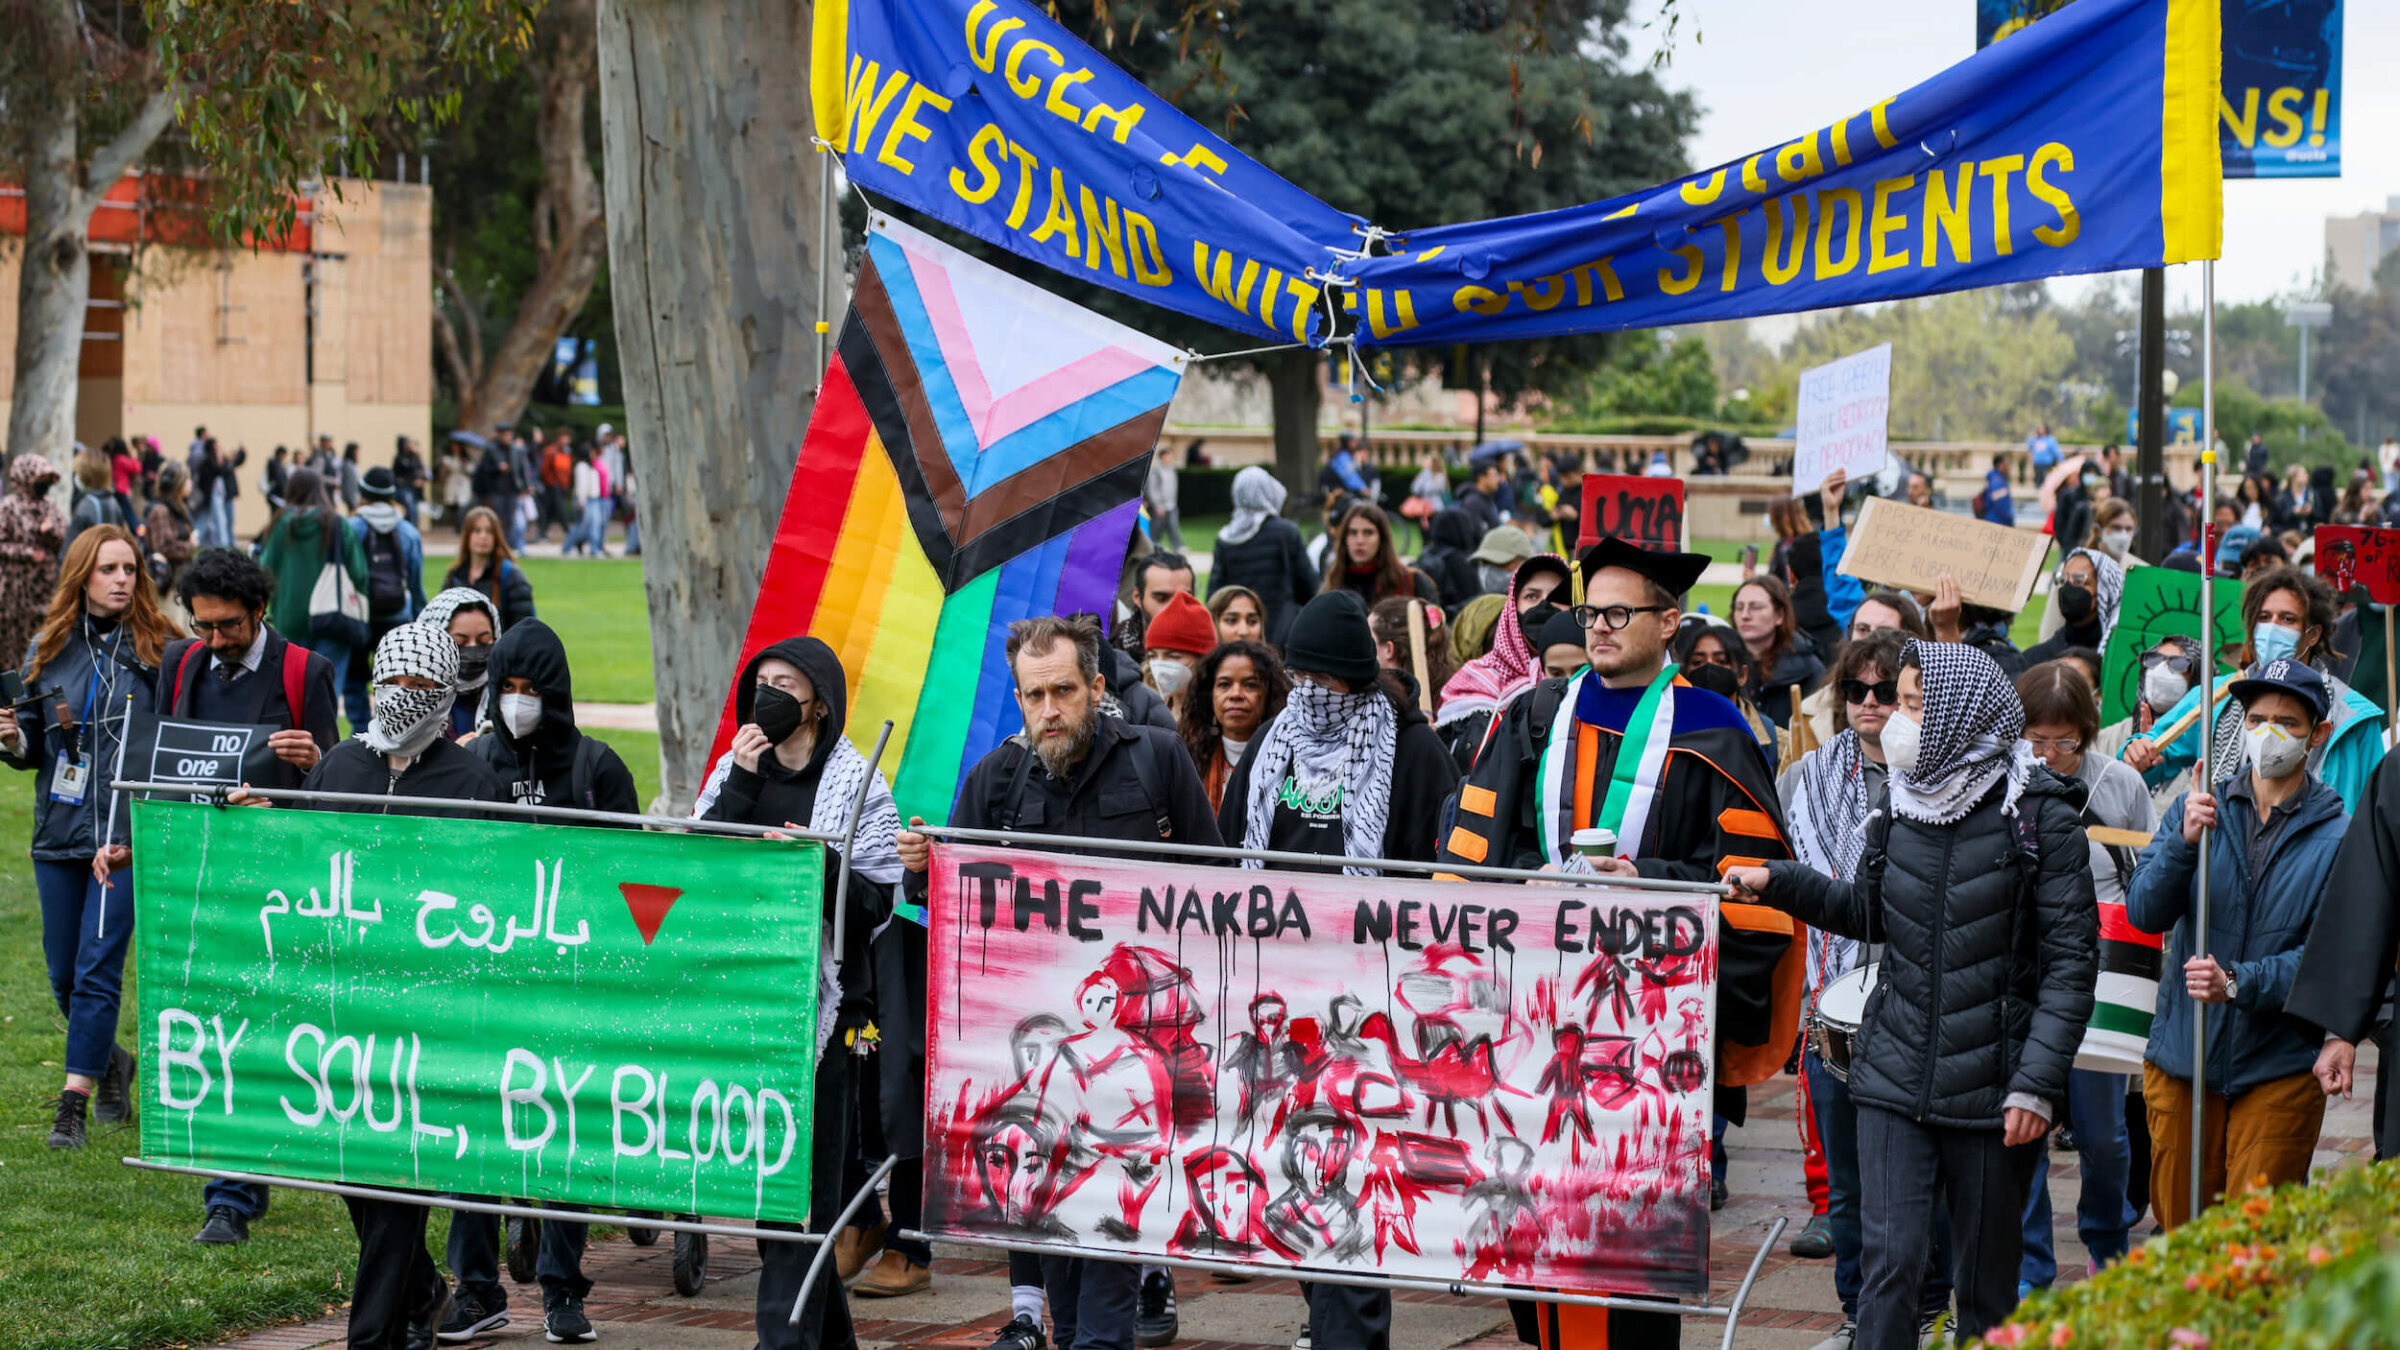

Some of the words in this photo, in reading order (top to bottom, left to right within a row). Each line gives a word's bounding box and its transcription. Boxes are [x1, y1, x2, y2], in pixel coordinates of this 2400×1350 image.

[846, 52, 952, 176] WE
[949, 123, 1173, 287] STAND
[1657, 142, 2081, 295] STUDENTS
[1874, 523, 1914, 544] FREE
[1880, 503, 1972, 535] PROTECT
[177, 758, 219, 777] one
[211, 734, 241, 752] no
[259, 849, 383, 956] بالدم
[415, 857, 590, 955] بالروح
[959, 861, 1104, 942] THE
[1138, 882, 1311, 942] NAKBA
[1353, 899, 1519, 953] NEVER
[1554, 899, 1706, 958] ENDED
[158, 1007, 249, 1116] BY
[279, 1023, 470, 1160] SOUL,
[500, 1048, 597, 1161] BY
[611, 1065, 797, 1176] BLOOD
